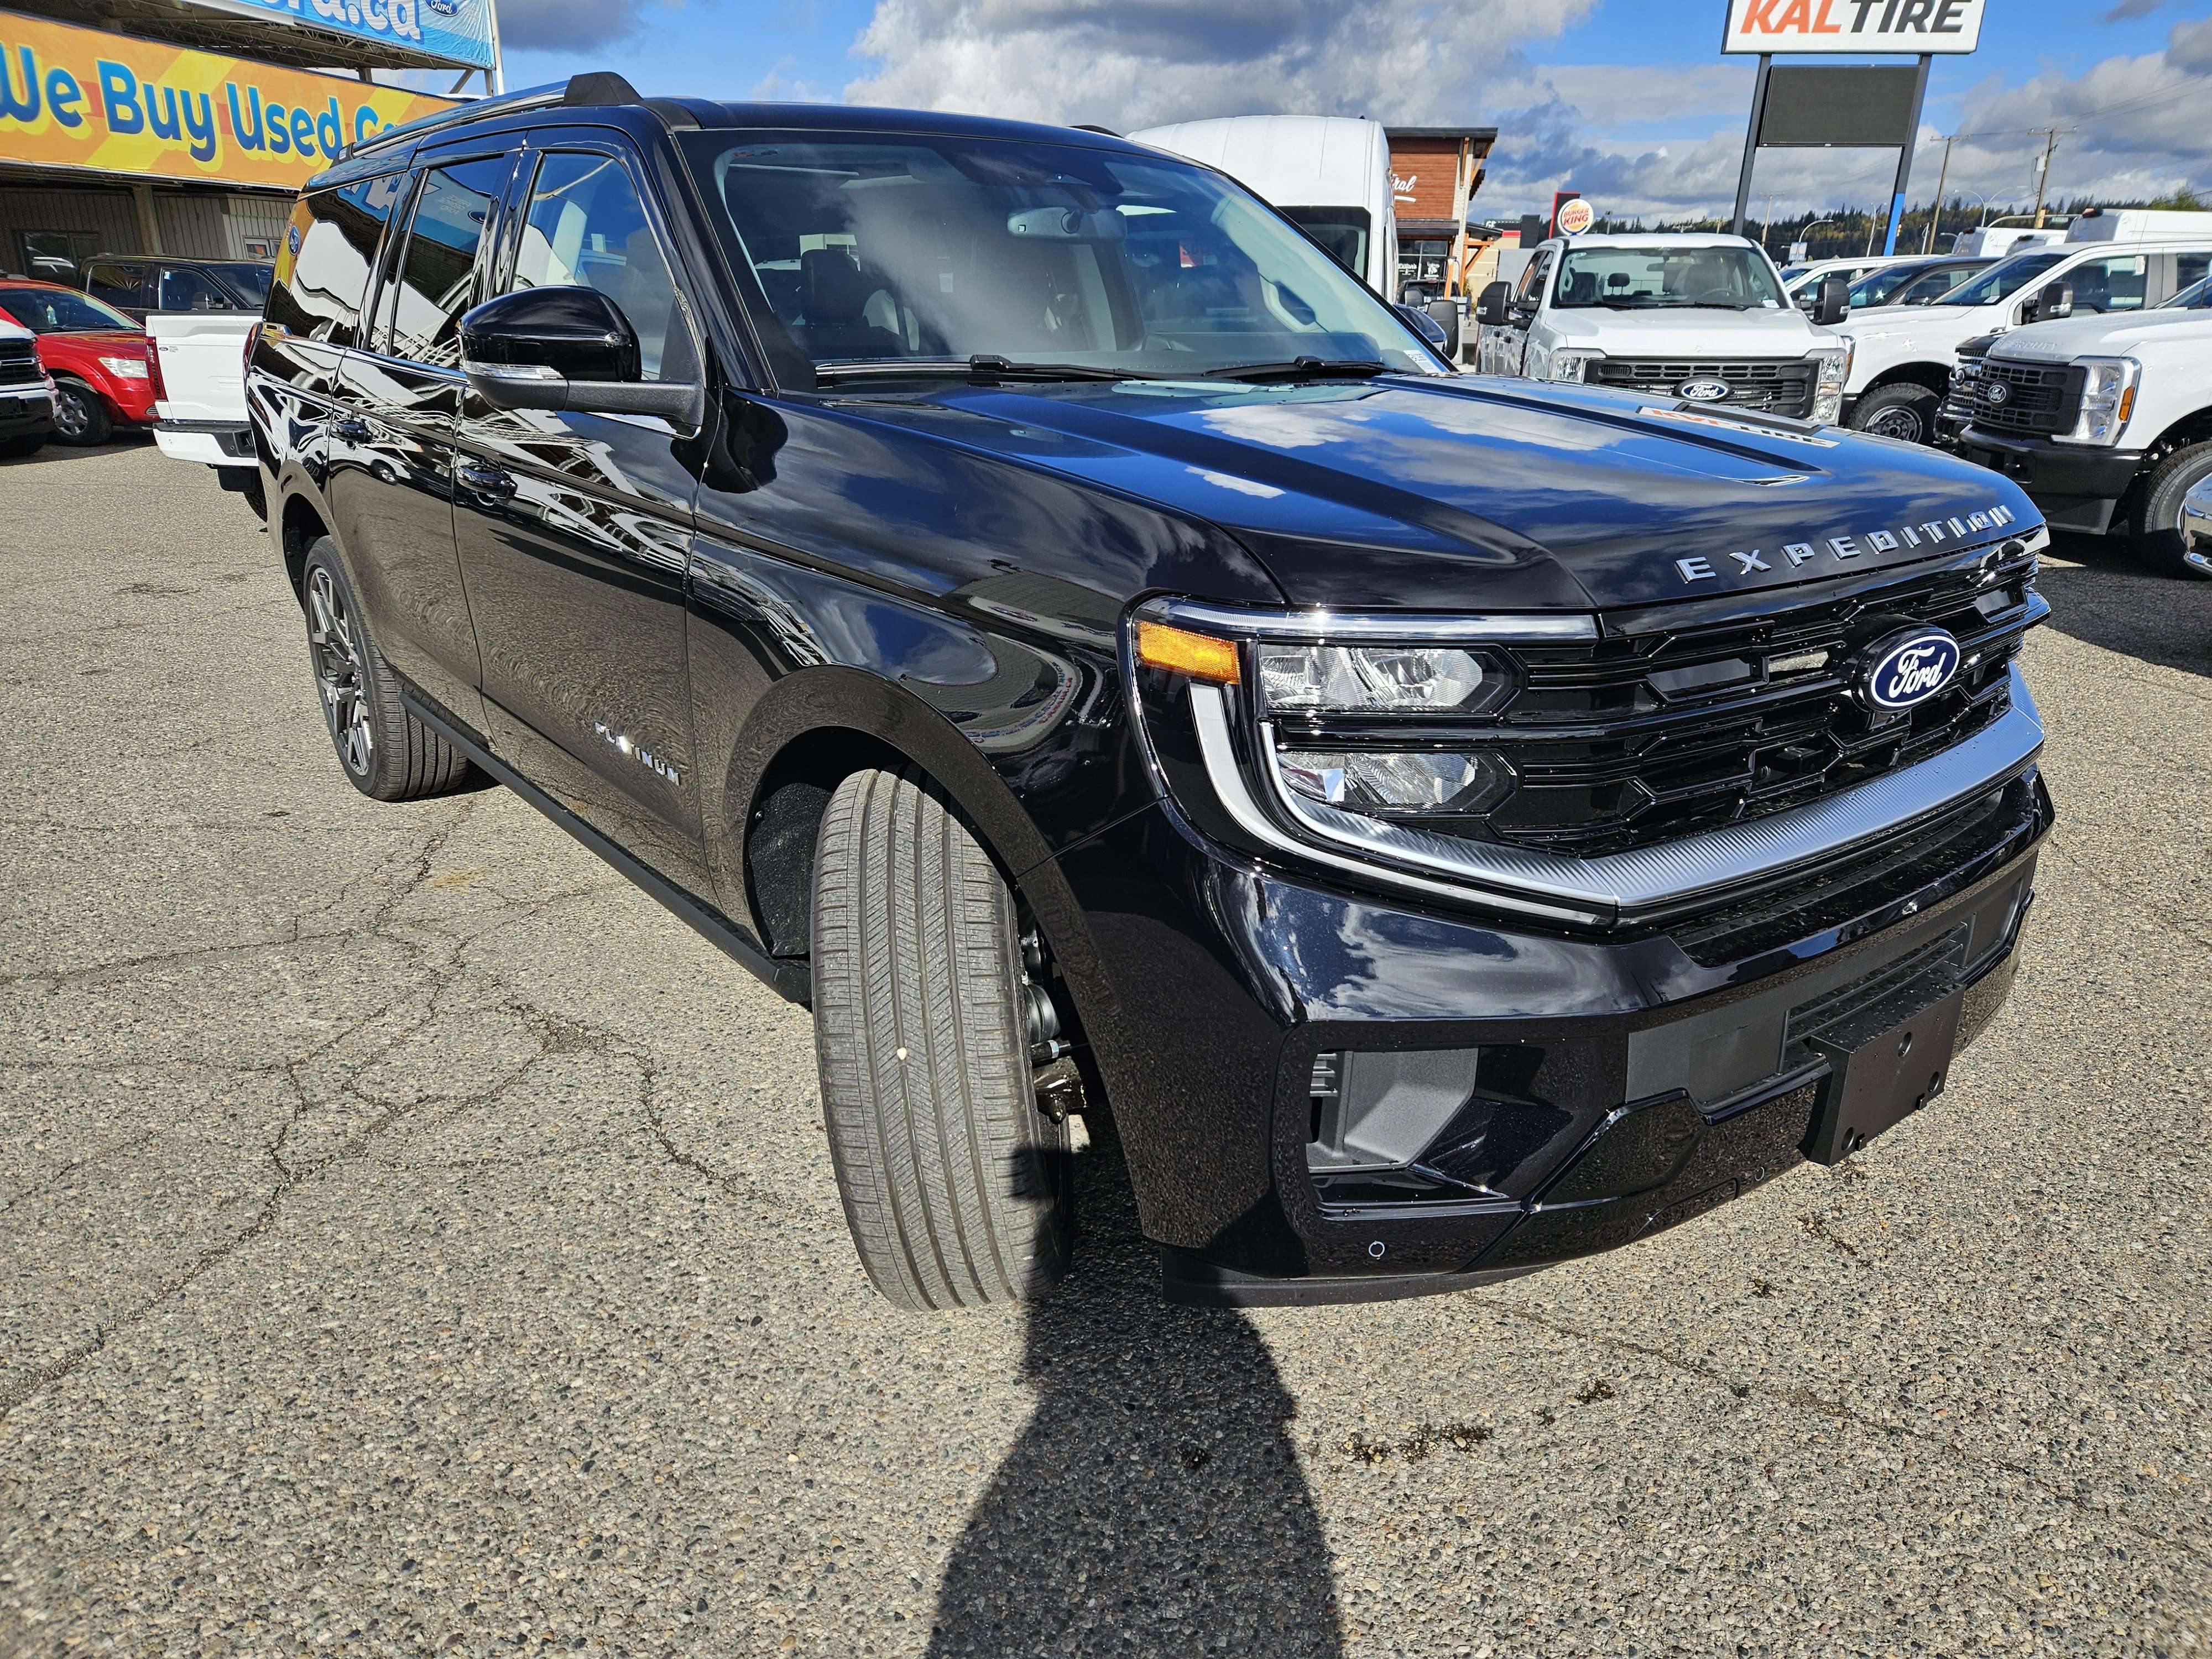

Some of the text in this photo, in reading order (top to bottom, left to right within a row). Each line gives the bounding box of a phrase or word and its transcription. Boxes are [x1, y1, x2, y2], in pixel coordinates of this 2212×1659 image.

[97, 59, 217, 162] Buy
[226, 82, 343, 160] Used
[1563, 208, 1589, 217] BURGER
[1563, 214, 1589, 226] KING
[1689, 384, 1719, 397] Ford
[1674, 504, 2016, 584] EXPEDITION
[1888, 646, 1945, 697] Ford
